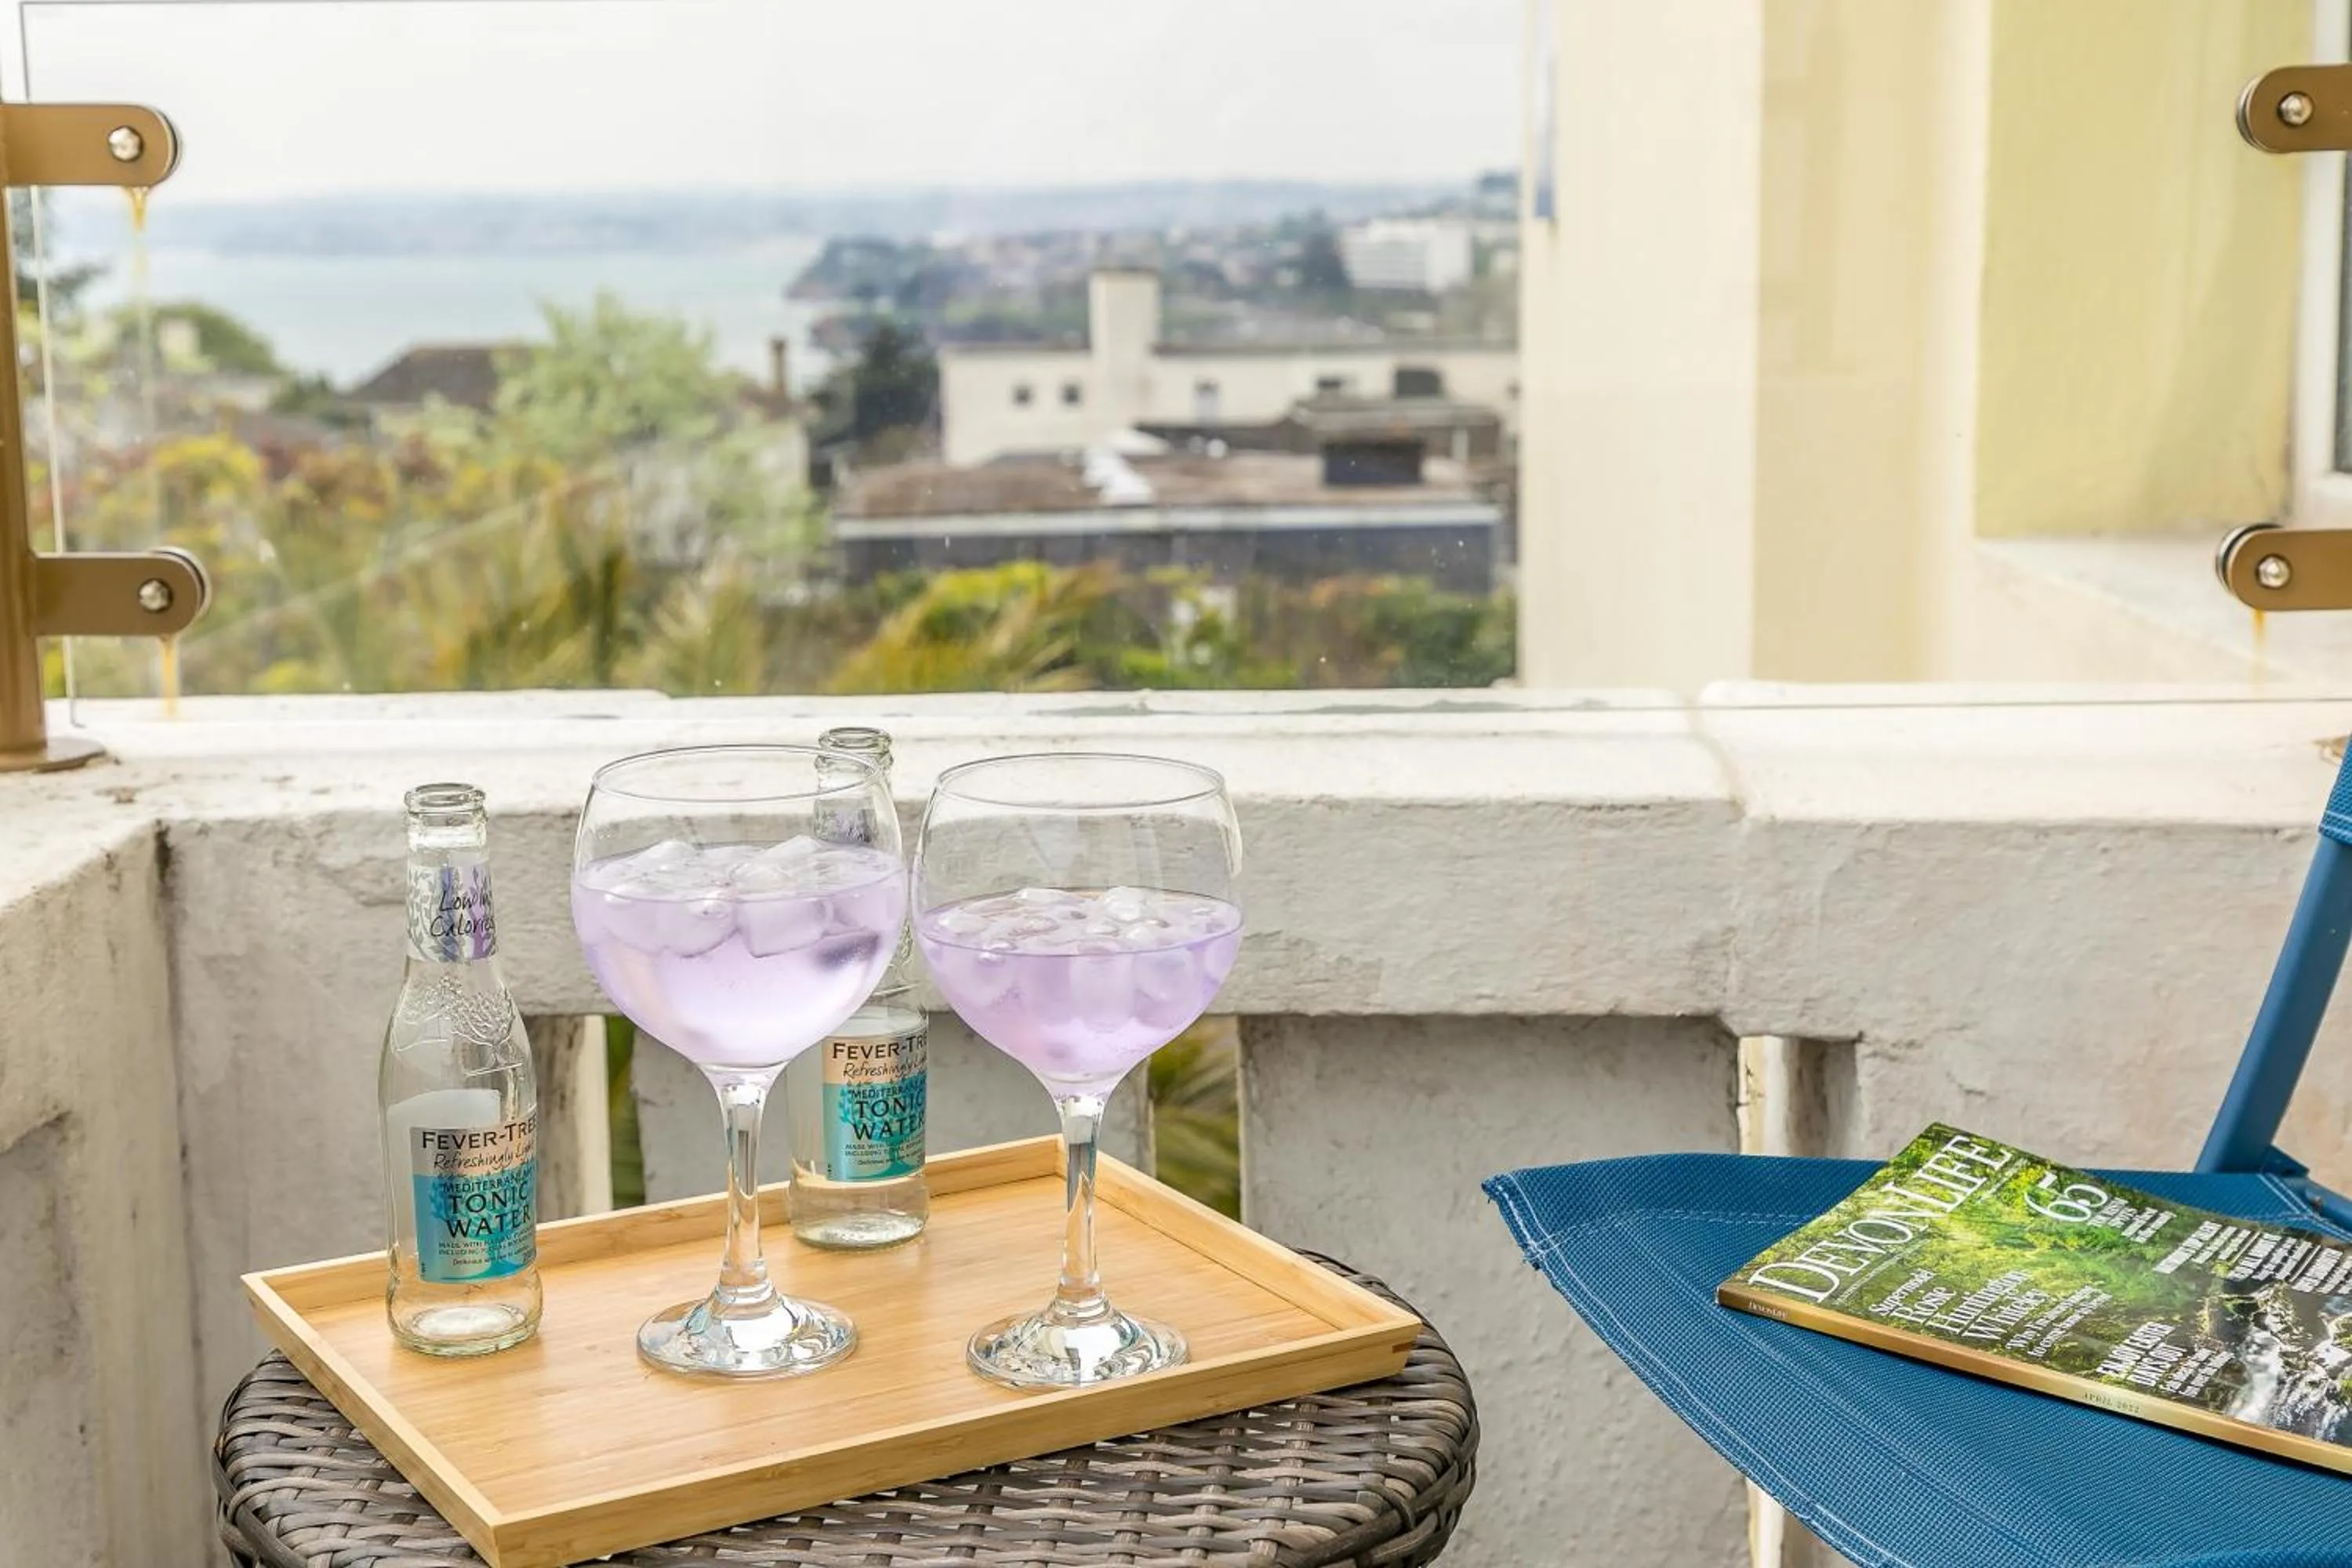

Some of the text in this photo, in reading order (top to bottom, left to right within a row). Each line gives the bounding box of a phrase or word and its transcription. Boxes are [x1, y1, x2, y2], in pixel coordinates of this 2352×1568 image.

[855, 1090, 924, 1120] TONIC
[852, 1110, 925, 1141] WATER
[433, 1146, 514, 1171] Refreshingly
[448, 1180, 528, 1214] TONIC
[2024, 1170, 2108, 1222] 65
[445, 1203, 532, 1239] WATER
[1868, 1268, 1936, 1316] Supermodel
[1890, 1286, 1958, 1325] Rosie
[1962, 1287, 2049, 1341] Whiteley
[2095, 1321, 2176, 1380] ENJOY EASTER
[2126, 1341, 2187, 1387] DAYS OUT
